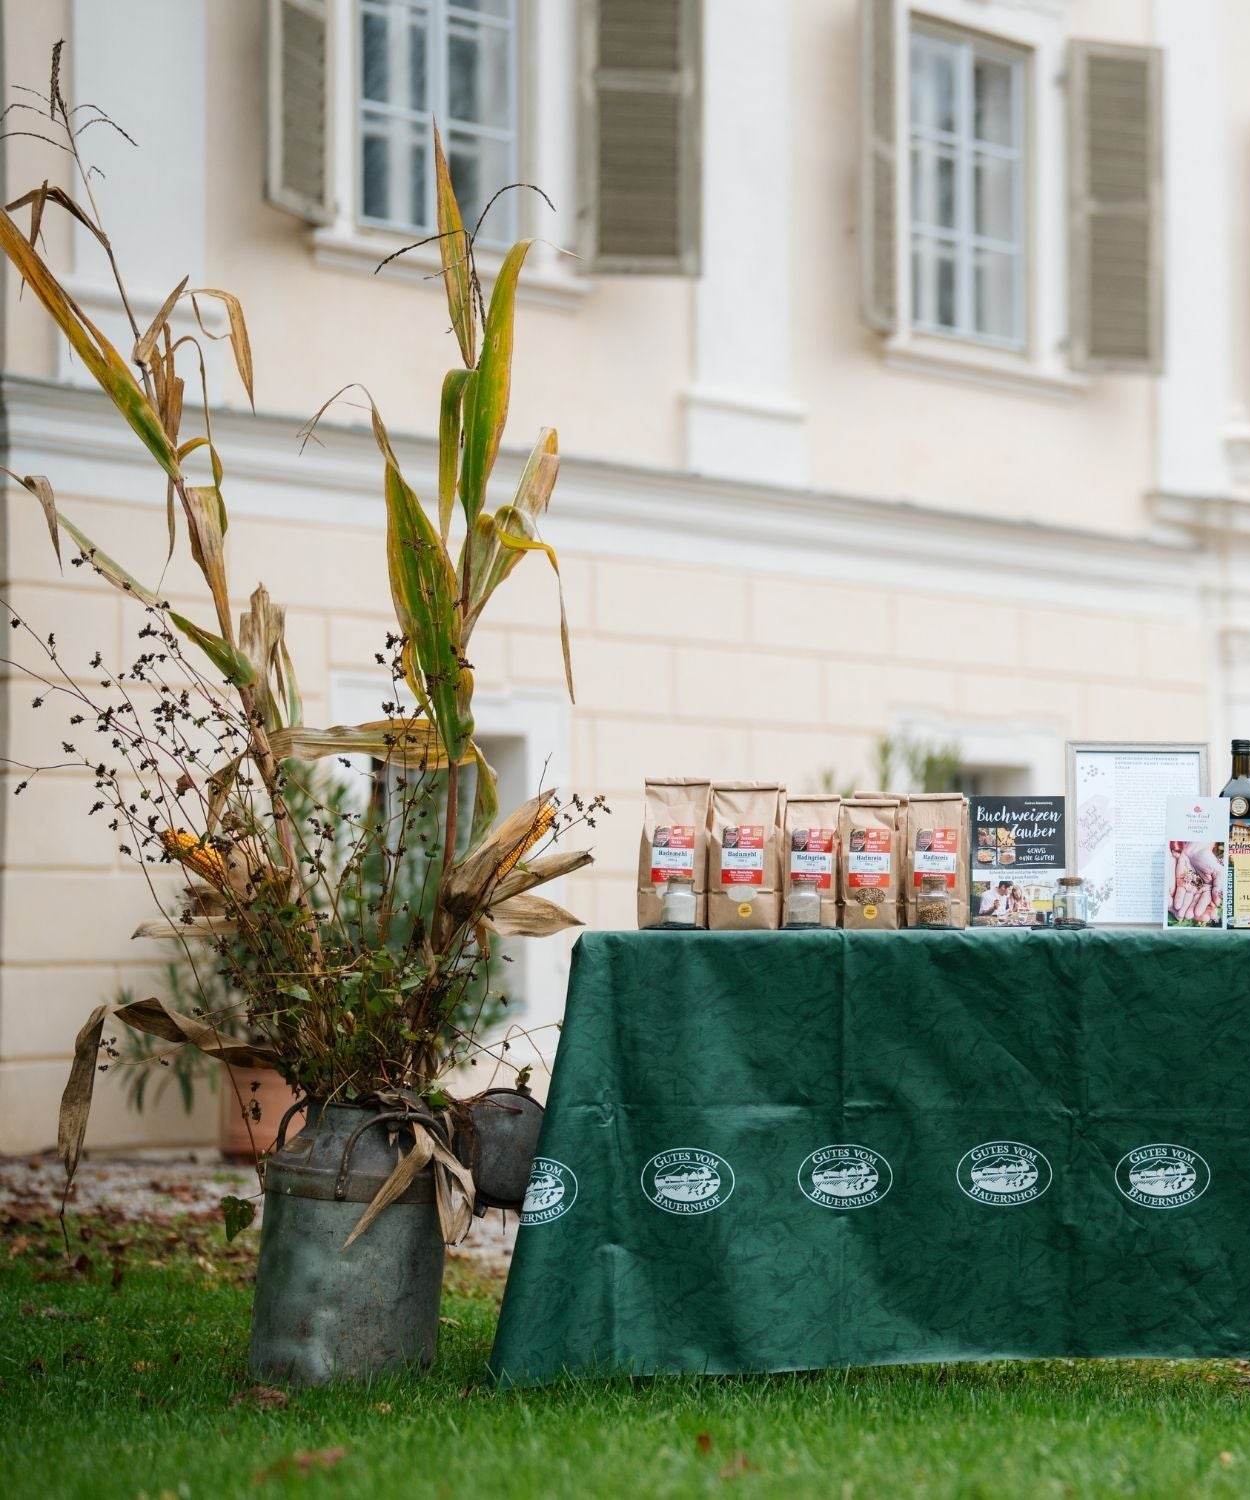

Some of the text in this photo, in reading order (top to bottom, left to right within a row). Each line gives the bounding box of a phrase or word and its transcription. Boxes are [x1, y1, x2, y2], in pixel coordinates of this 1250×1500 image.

[976, 805, 1062, 823] Buchweizen
[1010, 823, 1056, 839] Zauber
[653, 1152, 719, 1169] GUTES VOM
[812, 1148, 878, 1165] GUTES VOM
[970, 1145, 1038, 1162] GUTES VOM
[1129, 1147, 1196, 1164] GUTES VOM
[539, 1161, 563, 1176] VOM
[809, 1187, 878, 1207] BAUERNHOF
[968, 1183, 1038, 1203] BAUERNHOF
[1126, 1185, 1196, 1207] BAUERNHOF
[652, 1191, 720, 1213] BAUERNHOF
